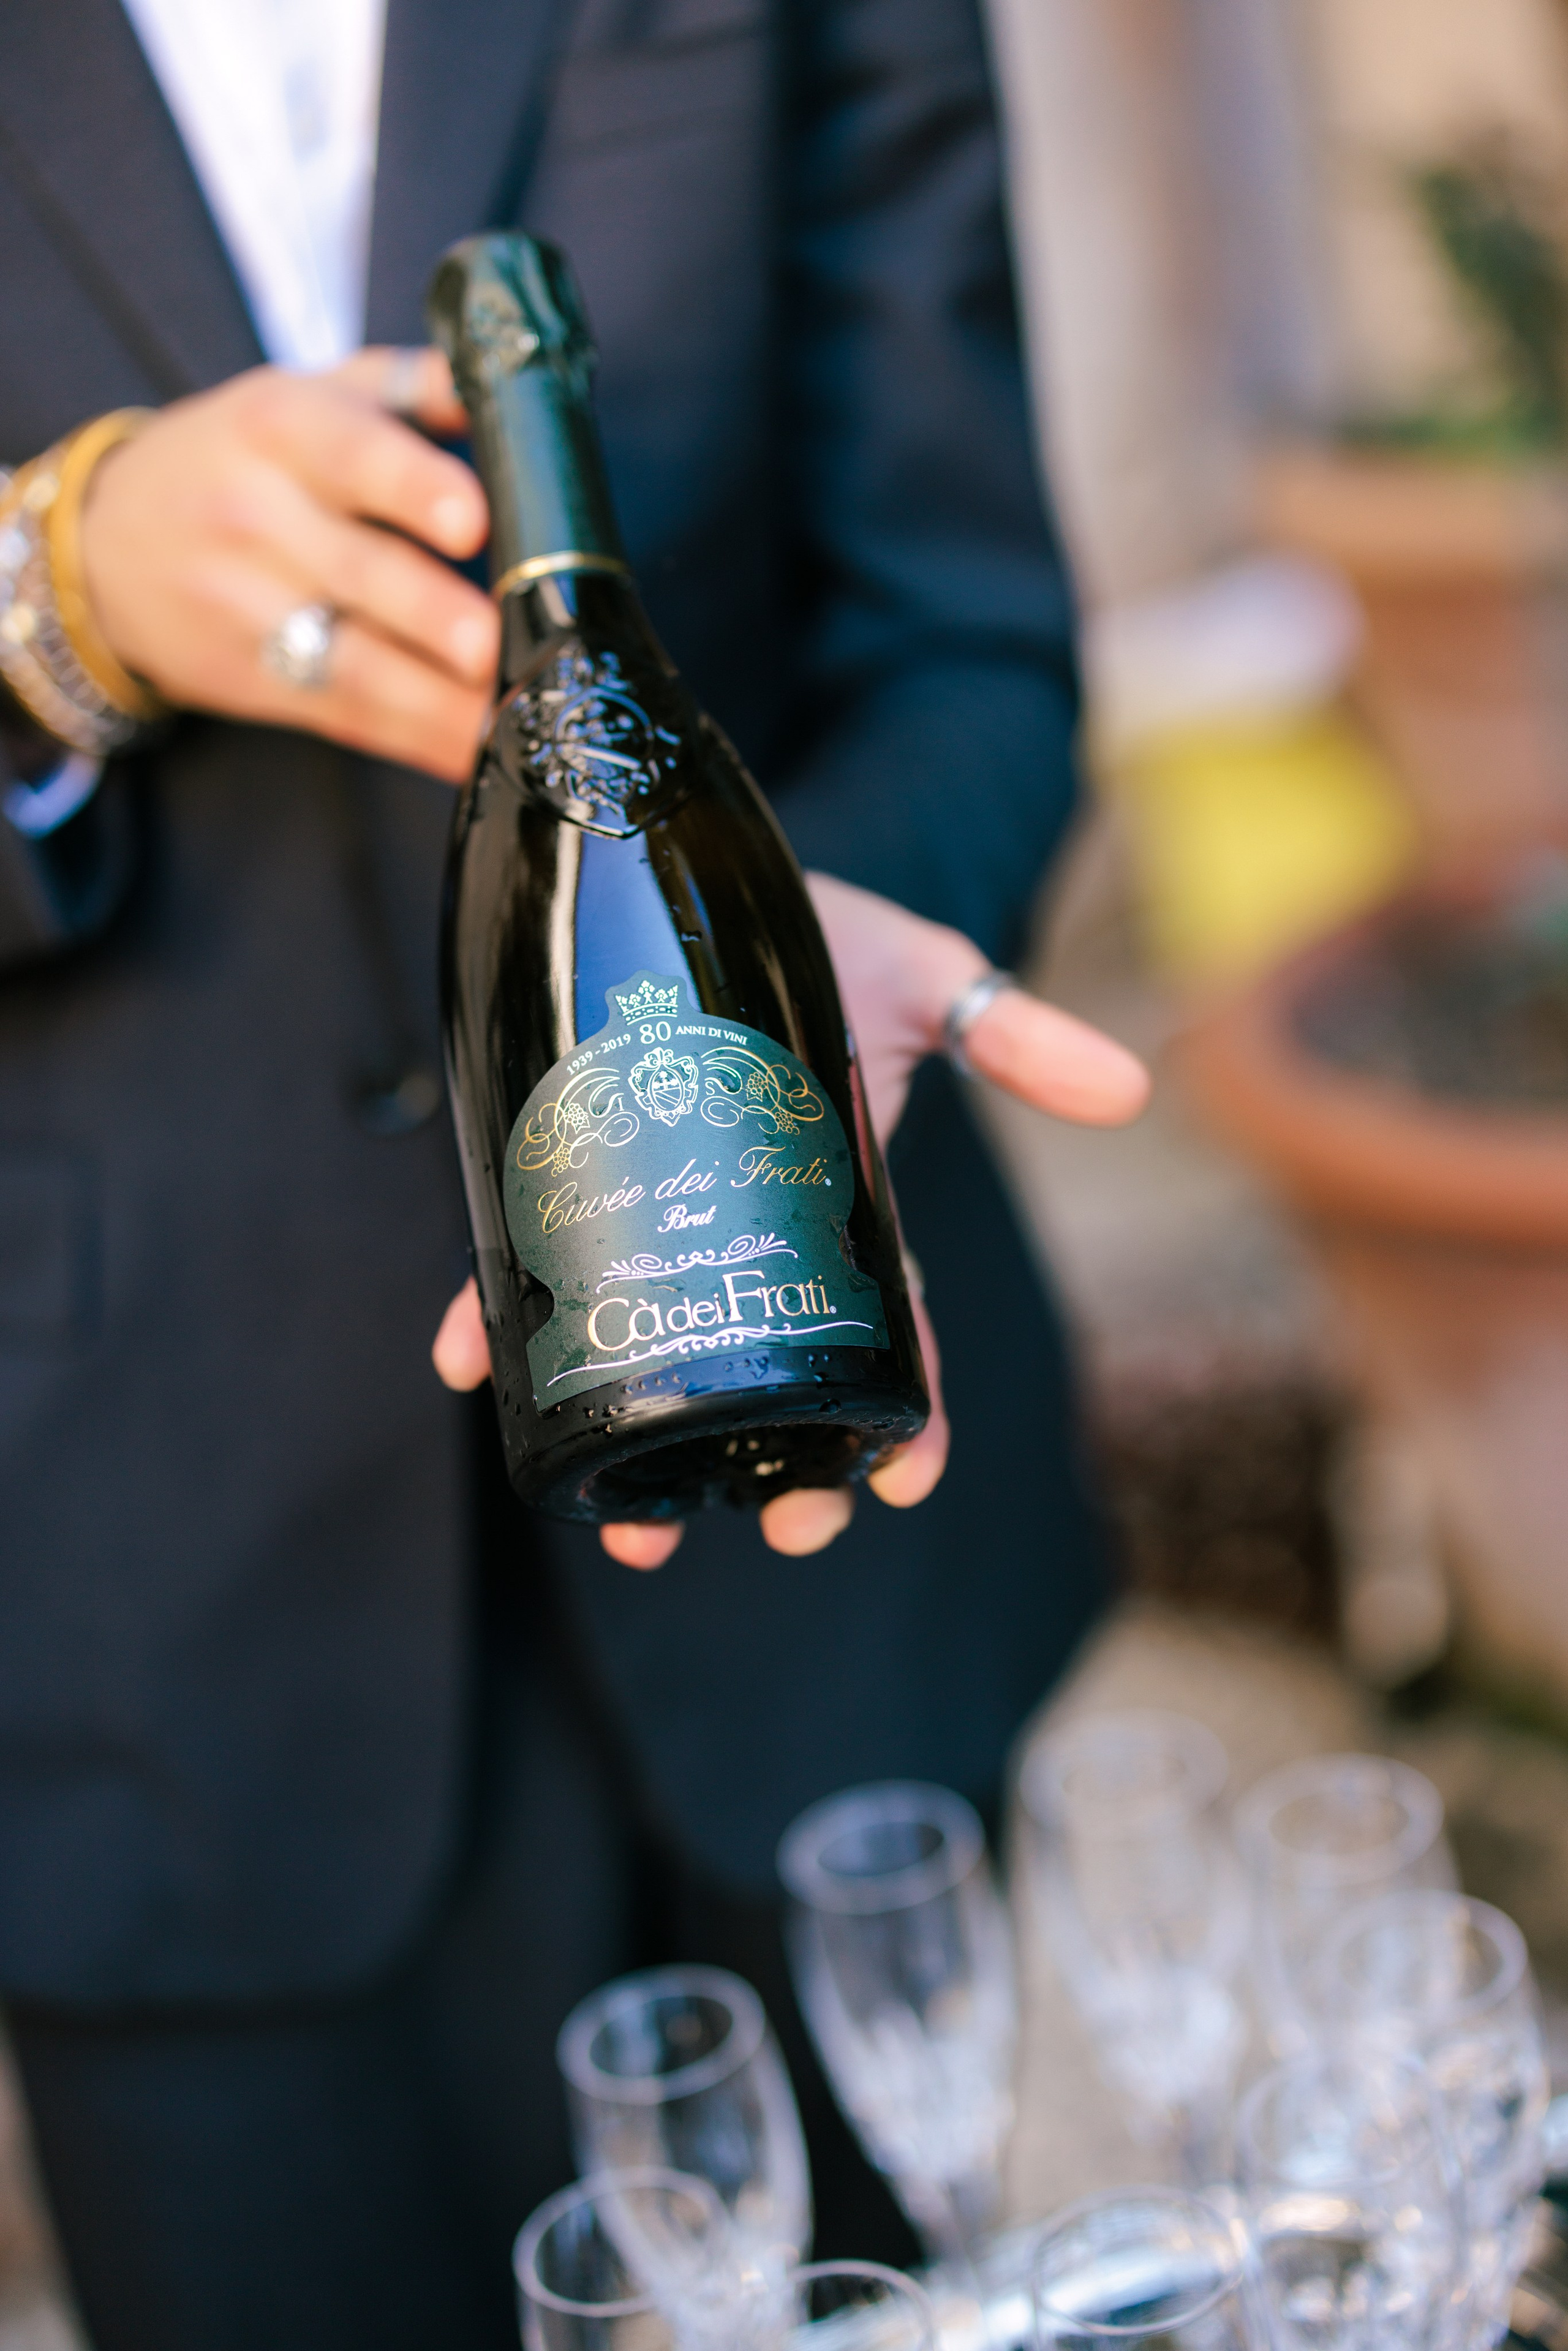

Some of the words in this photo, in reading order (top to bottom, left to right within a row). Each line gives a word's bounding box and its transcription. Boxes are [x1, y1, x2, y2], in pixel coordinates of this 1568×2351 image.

[567, 1051, 593, 1075] 1939
[601, 1033, 631, 1053] 2019
[639, 1021, 671, 1044] 80
[675, 1025, 706, 1035] ANNI
[708, 1027, 722, 1038] DI
[723, 1030, 747, 1046] VINI
[538, 1177, 646, 1233] Cuvée
[655, 1158, 719, 1200] dei
[657, 1204, 717, 1232] Brut
